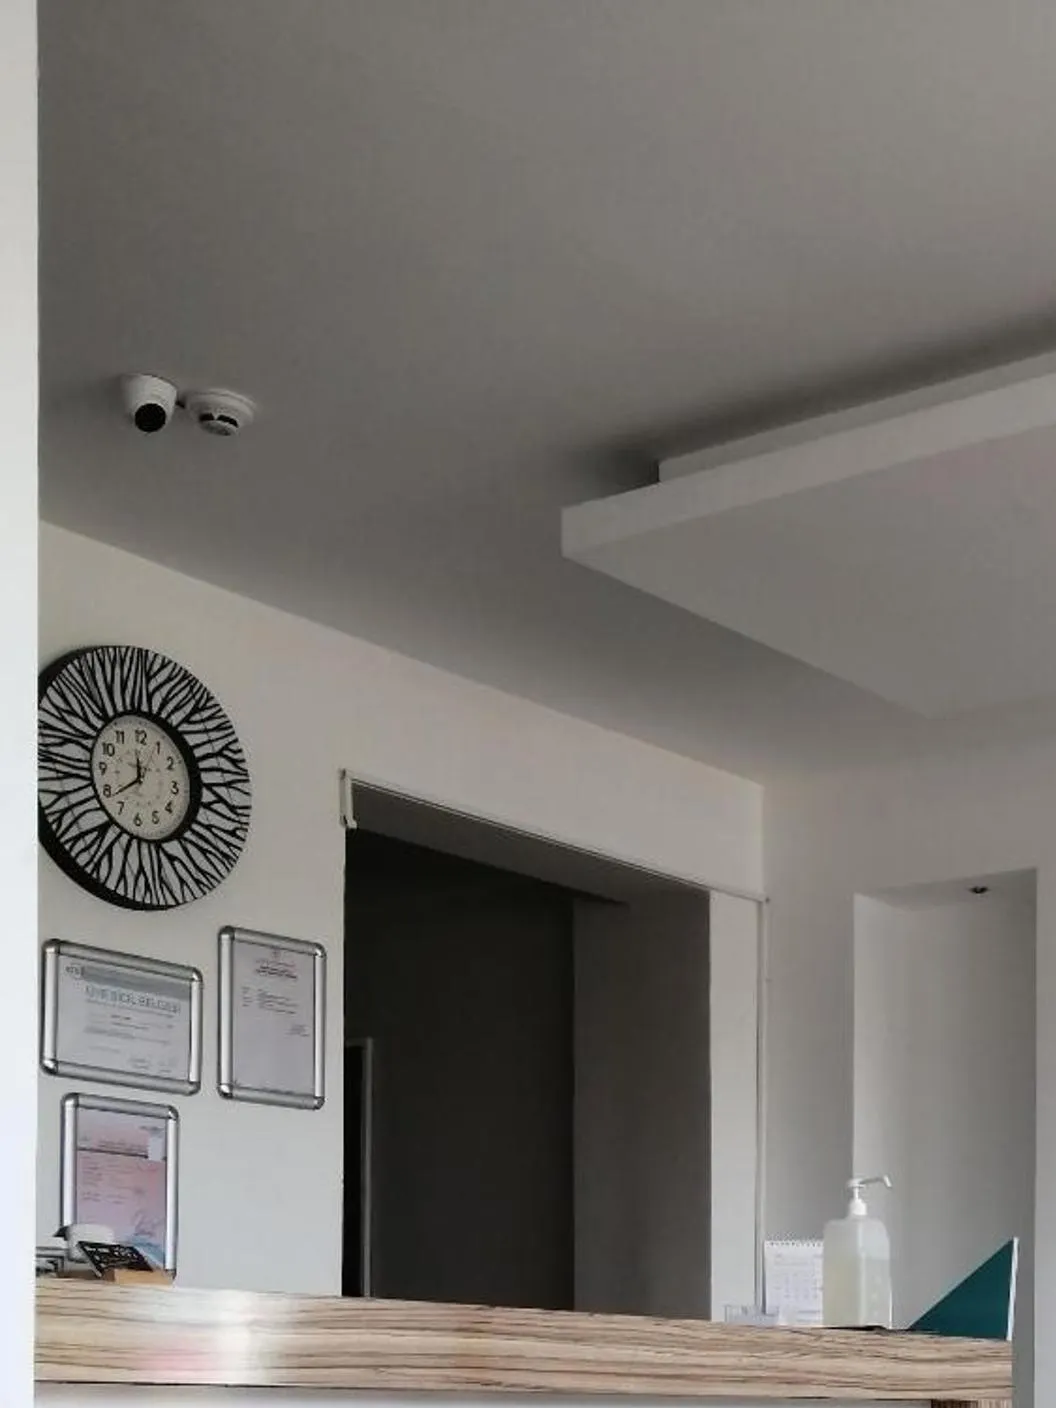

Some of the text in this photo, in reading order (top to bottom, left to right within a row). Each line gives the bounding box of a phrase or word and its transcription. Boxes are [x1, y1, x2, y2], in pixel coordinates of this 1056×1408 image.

[115, 730, 125, 744] 11
[135, 729, 147, 745] 12
[102, 742, 115, 757] 10
[155, 741, 161, 755] 1
[99, 762, 108, 775] 9
[166, 756, 174, 770] 2
[103, 784, 111, 798] 8
[171, 781, 179, 795] 3
[117, 801, 124, 815] 7
[164, 801, 173, 814] 4
[133, 813, 142, 826] 6
[152, 811, 159, 824] 5
